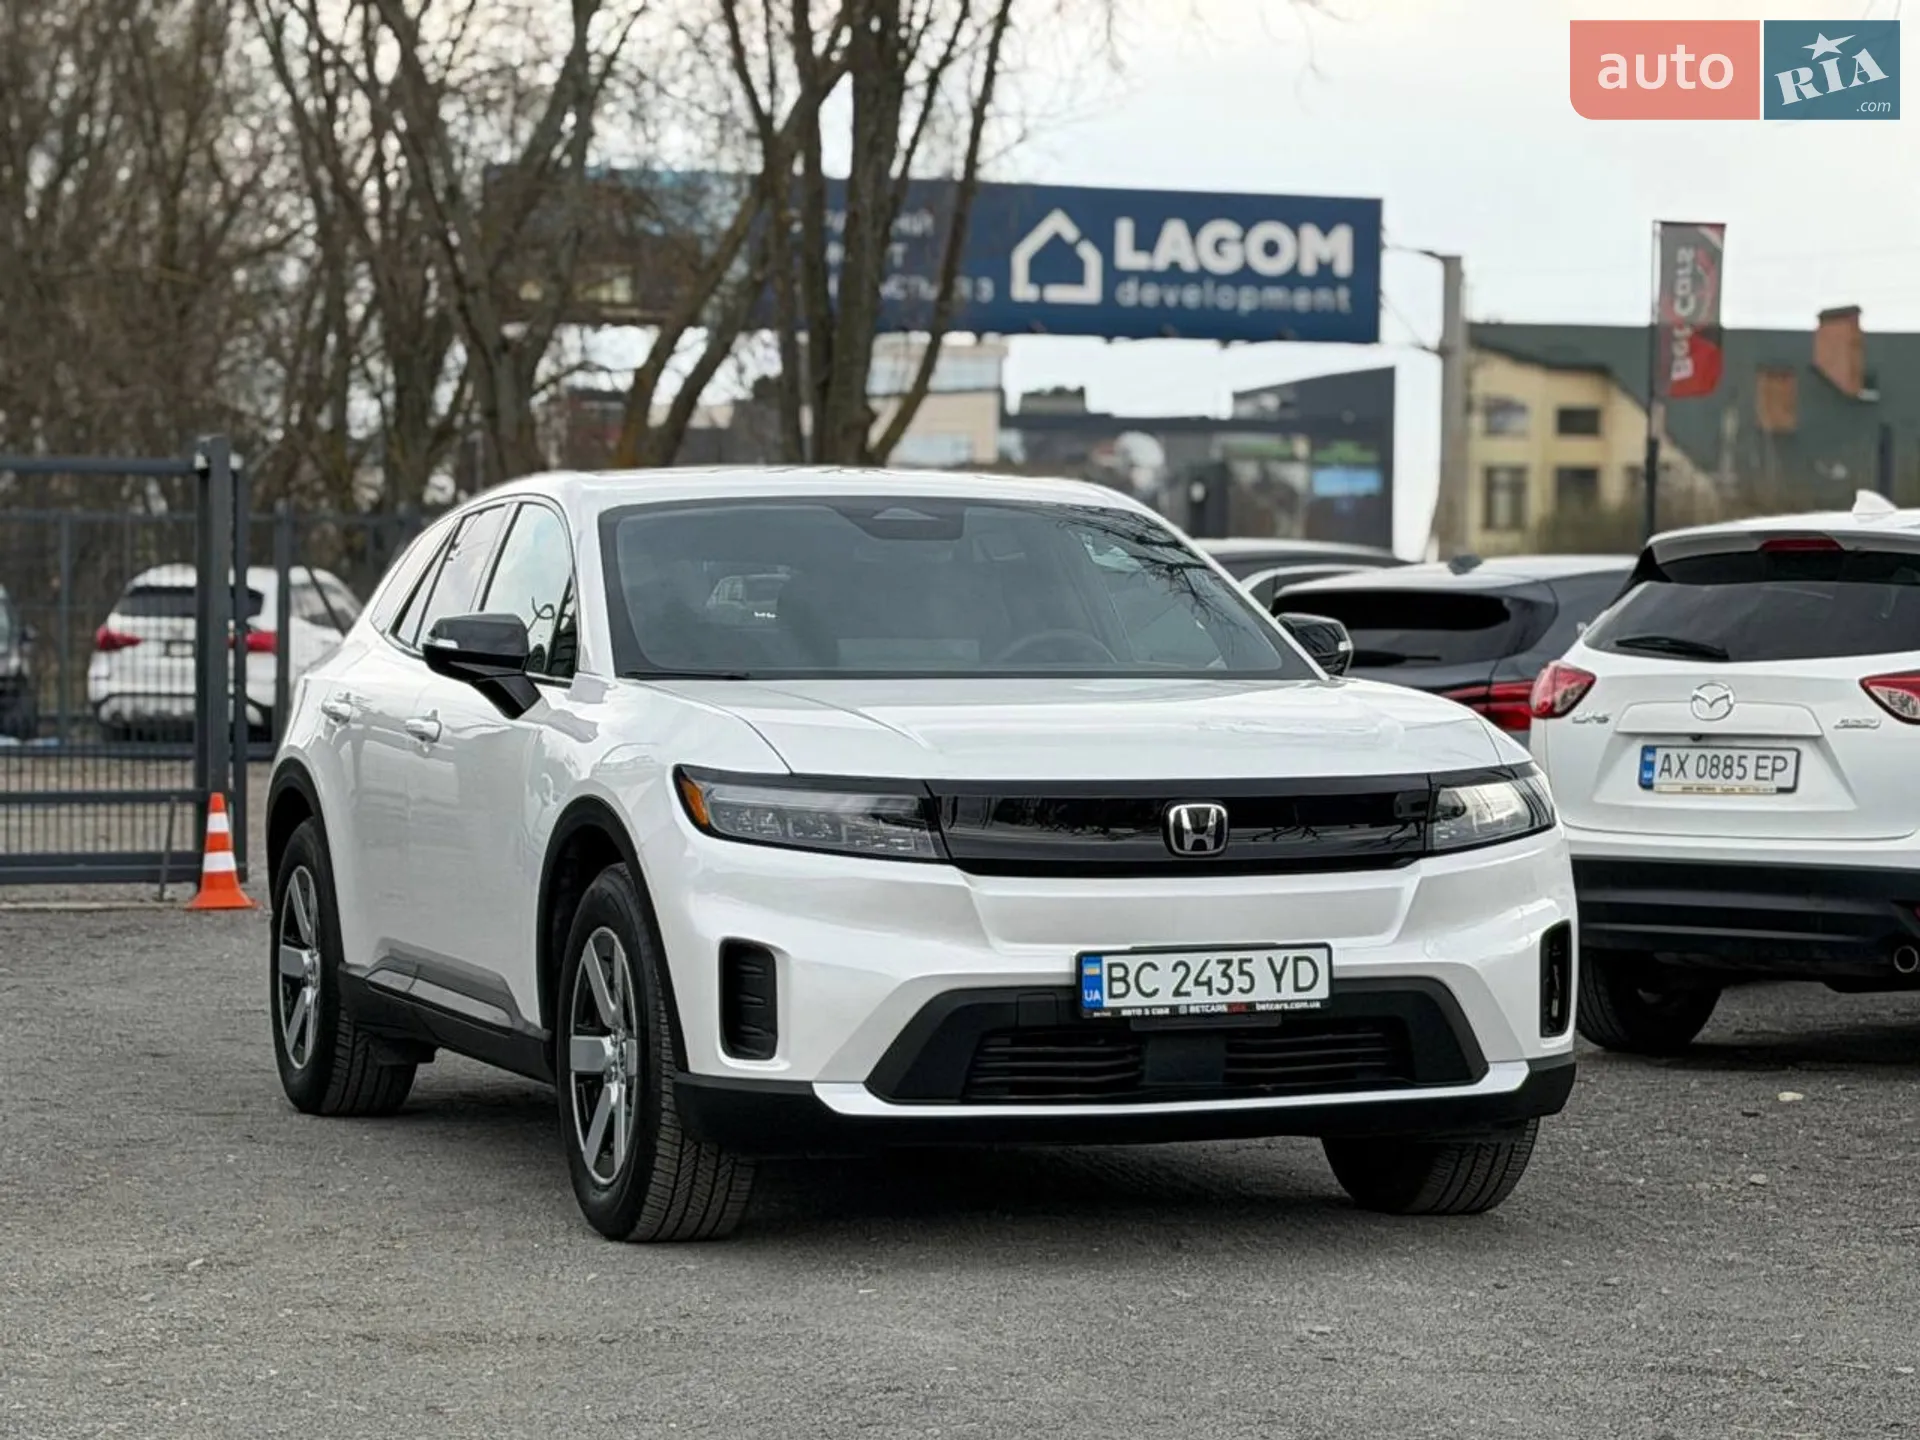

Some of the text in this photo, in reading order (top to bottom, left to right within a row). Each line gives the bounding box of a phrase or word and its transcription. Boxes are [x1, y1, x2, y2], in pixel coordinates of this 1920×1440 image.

[1113, 216, 1354, 279] LAGOM
[1114, 276, 1353, 317] development
[1659, 753, 1788, 781] AX 0885 EP
[1083, 988, 1101, 1001] UA
[1106, 955, 1320, 1000] BC 2435 YD
[1255, 1000, 1322, 1011] betcars.com.ua
